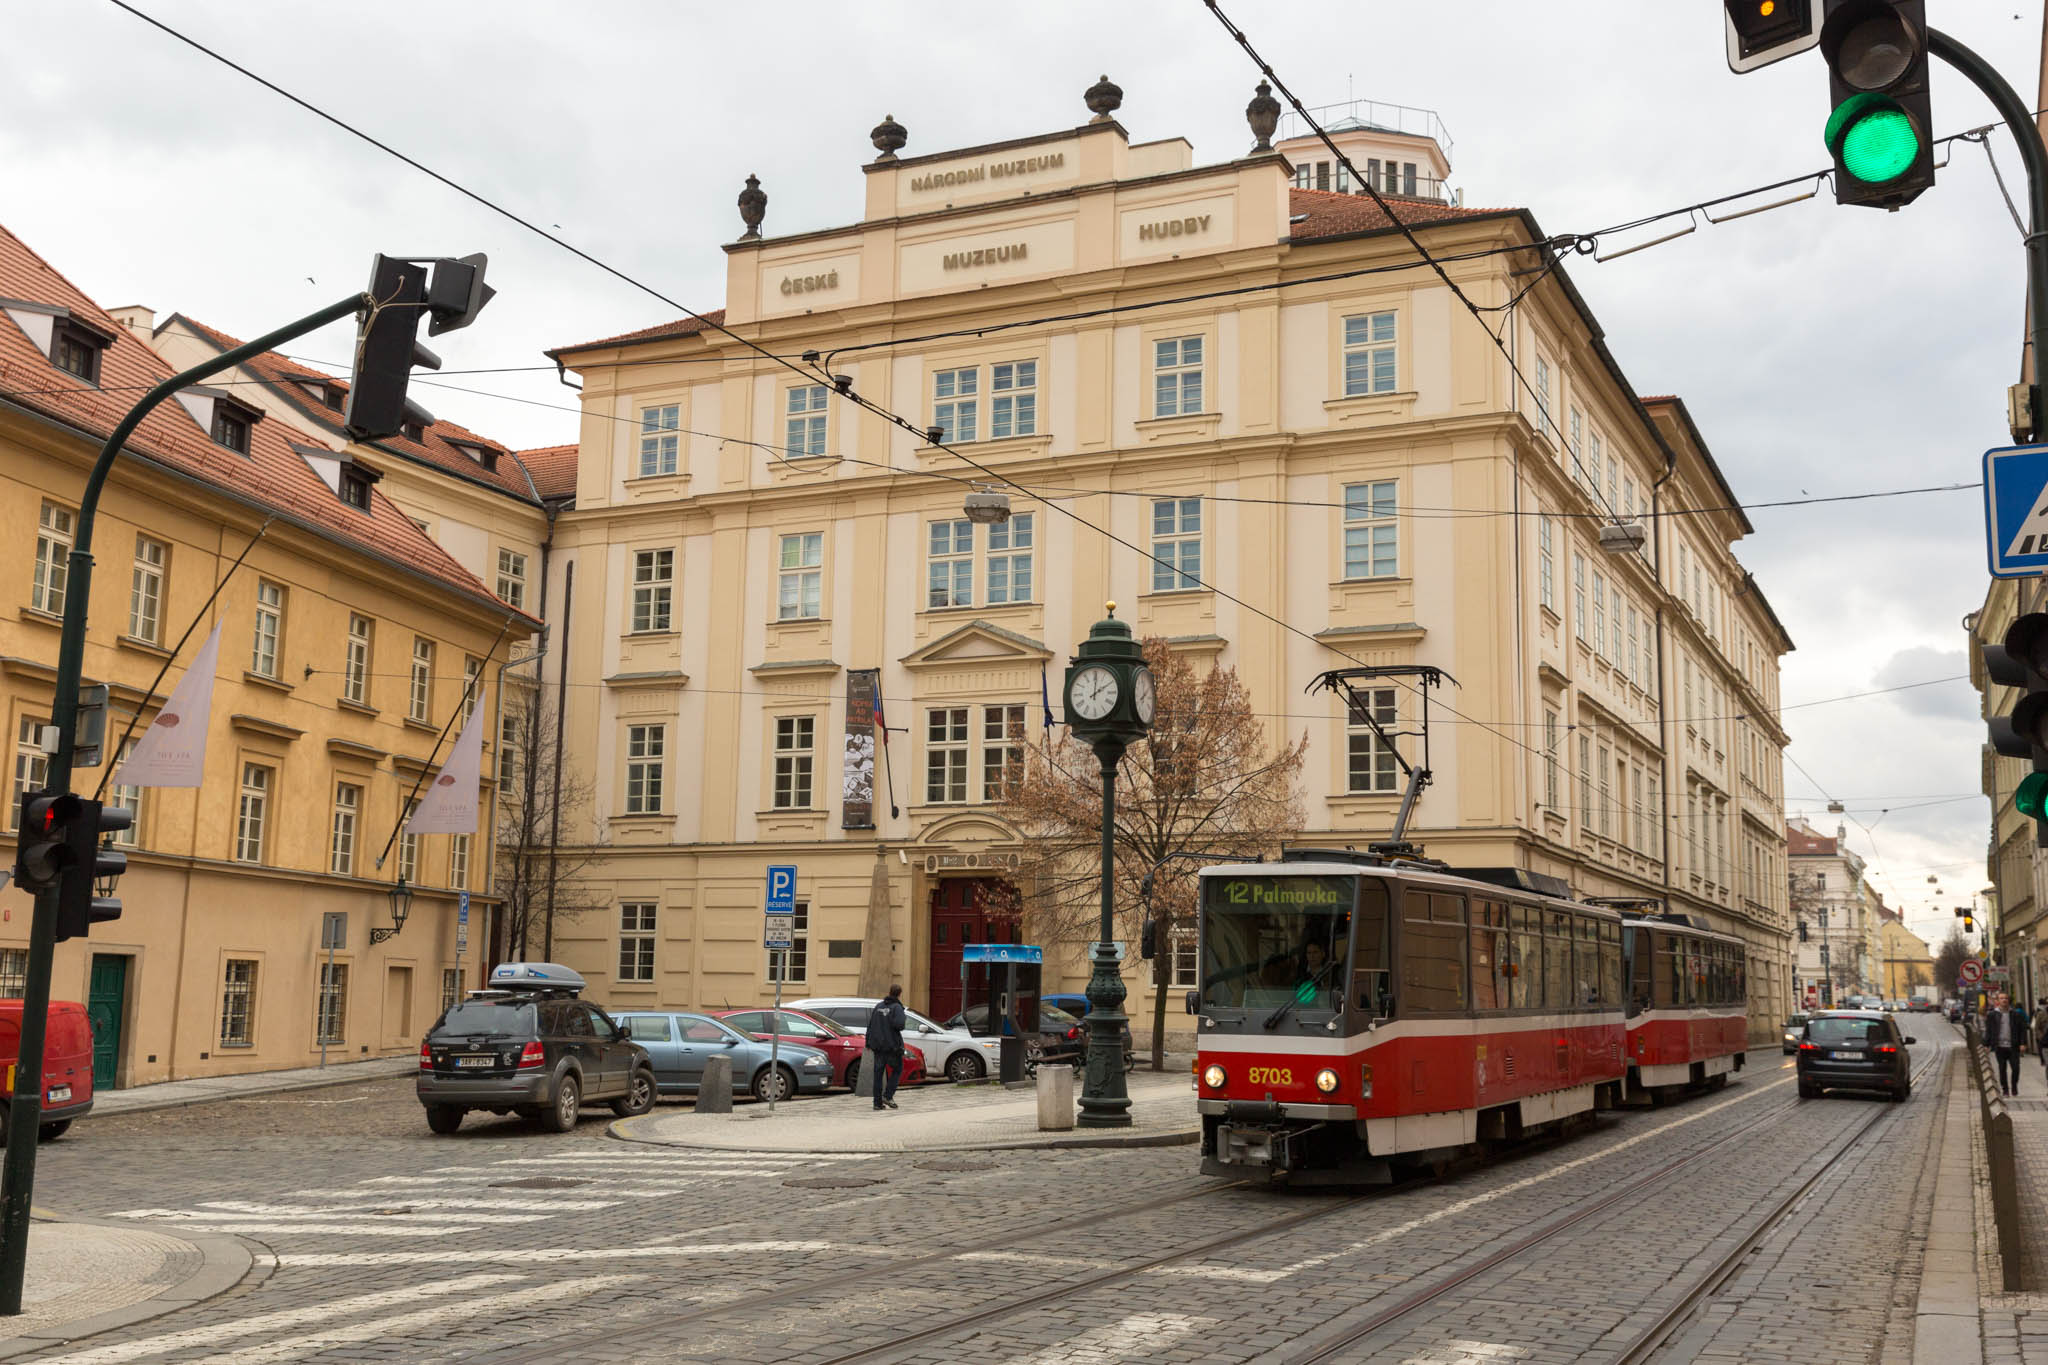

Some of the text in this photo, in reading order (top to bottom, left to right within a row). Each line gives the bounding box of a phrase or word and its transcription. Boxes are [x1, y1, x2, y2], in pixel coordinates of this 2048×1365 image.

[911, 153, 1064, 192] NÁRODNÍ MUZEUM
[780, 215, 1211, 296] ČESKÉ MUZEUM HUDBY
[773, 871, 790, 899] P
[1224, 882, 1337, 904] 12 Palmovka
[1249, 1067, 1292, 1085] 8703
